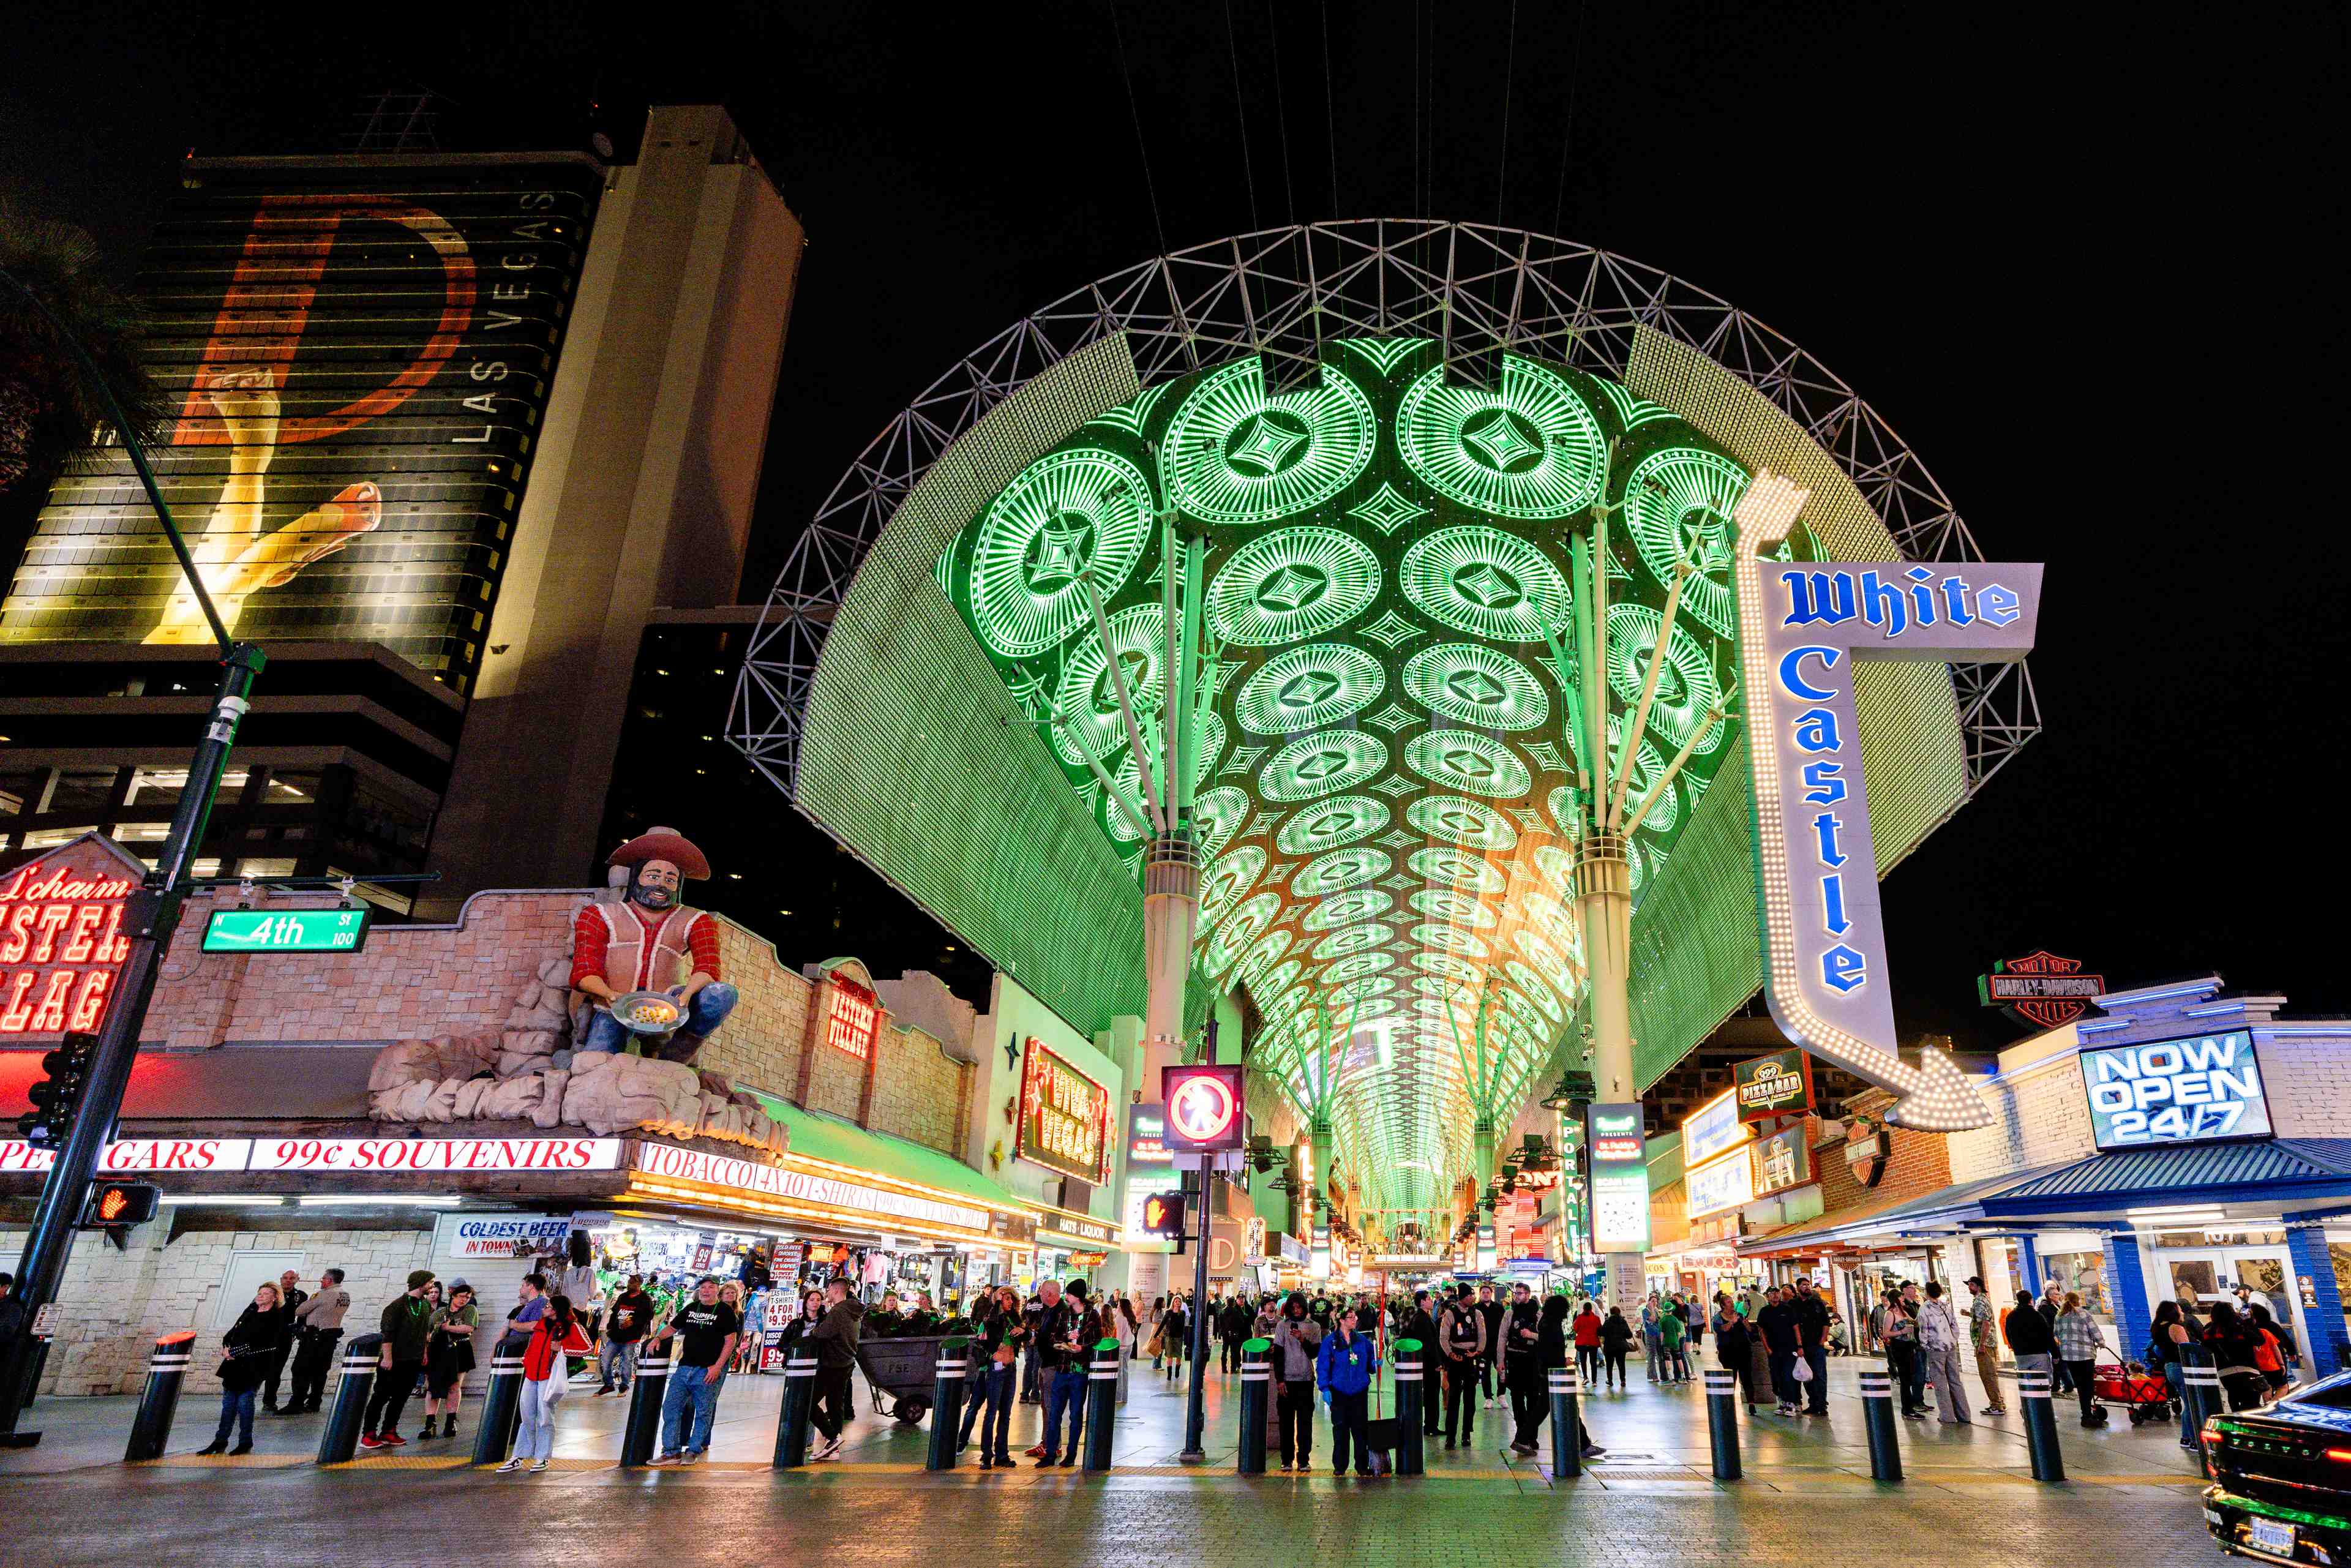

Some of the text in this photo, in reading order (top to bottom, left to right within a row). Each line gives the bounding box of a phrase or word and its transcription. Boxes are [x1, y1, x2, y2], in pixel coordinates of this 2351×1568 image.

[452, 190, 555, 444] LAS VEGAS
[1780, 565, 2020, 638] White
[1779, 644, 1869, 997] Castle
[214, 914, 352, 944] N 4th St
[332, 932, 354, 945] 100
[2016, 955, 2071, 973] MOTOR
[1995, 978, 2100, 997] HARLEY-DAVIDSON
[830, 989, 874, 1034] WESTERN
[828, 1018, 870, 1059] VILLAGE
[2096, 1035, 2237, 1082] NOW
[1052, 1065, 1090, 1124] VIVA
[1742, 1076, 1799, 1101] PIZZA BAR
[2090, 1065, 2262, 1113] OPEN
[1041, 1106, 1095, 1166] VEGAS
[2112, 1100, 2244, 1143] 24/7
[107, 1140, 221, 1169] GARS
[274, 1139, 596, 1169] 99¢ SOUVENIRS
[647, 1144, 753, 1187] TOBACCO
[760, 1168, 804, 1197] 4X10
[804, 1174, 873, 1209] T-SHIRTS
[459, 1221, 569, 1239] COLDEST BEER
[1059, 1218, 1076, 1234] HATS
[1081, 1224, 1104, 1239] LIQUOR
[465, 1240, 513, 1254] IN TOWN
[1071, 1255, 1103, 1264] LIQUOR
[1210, 1237, 1235, 1270] D
[1684, 1255, 1734, 1270] LIQUOR
[688, 1311, 718, 1321] TRIUMPH
[768, 1315, 793, 1326] $9.99
[770, 1304, 793, 1314] 4 FOR
